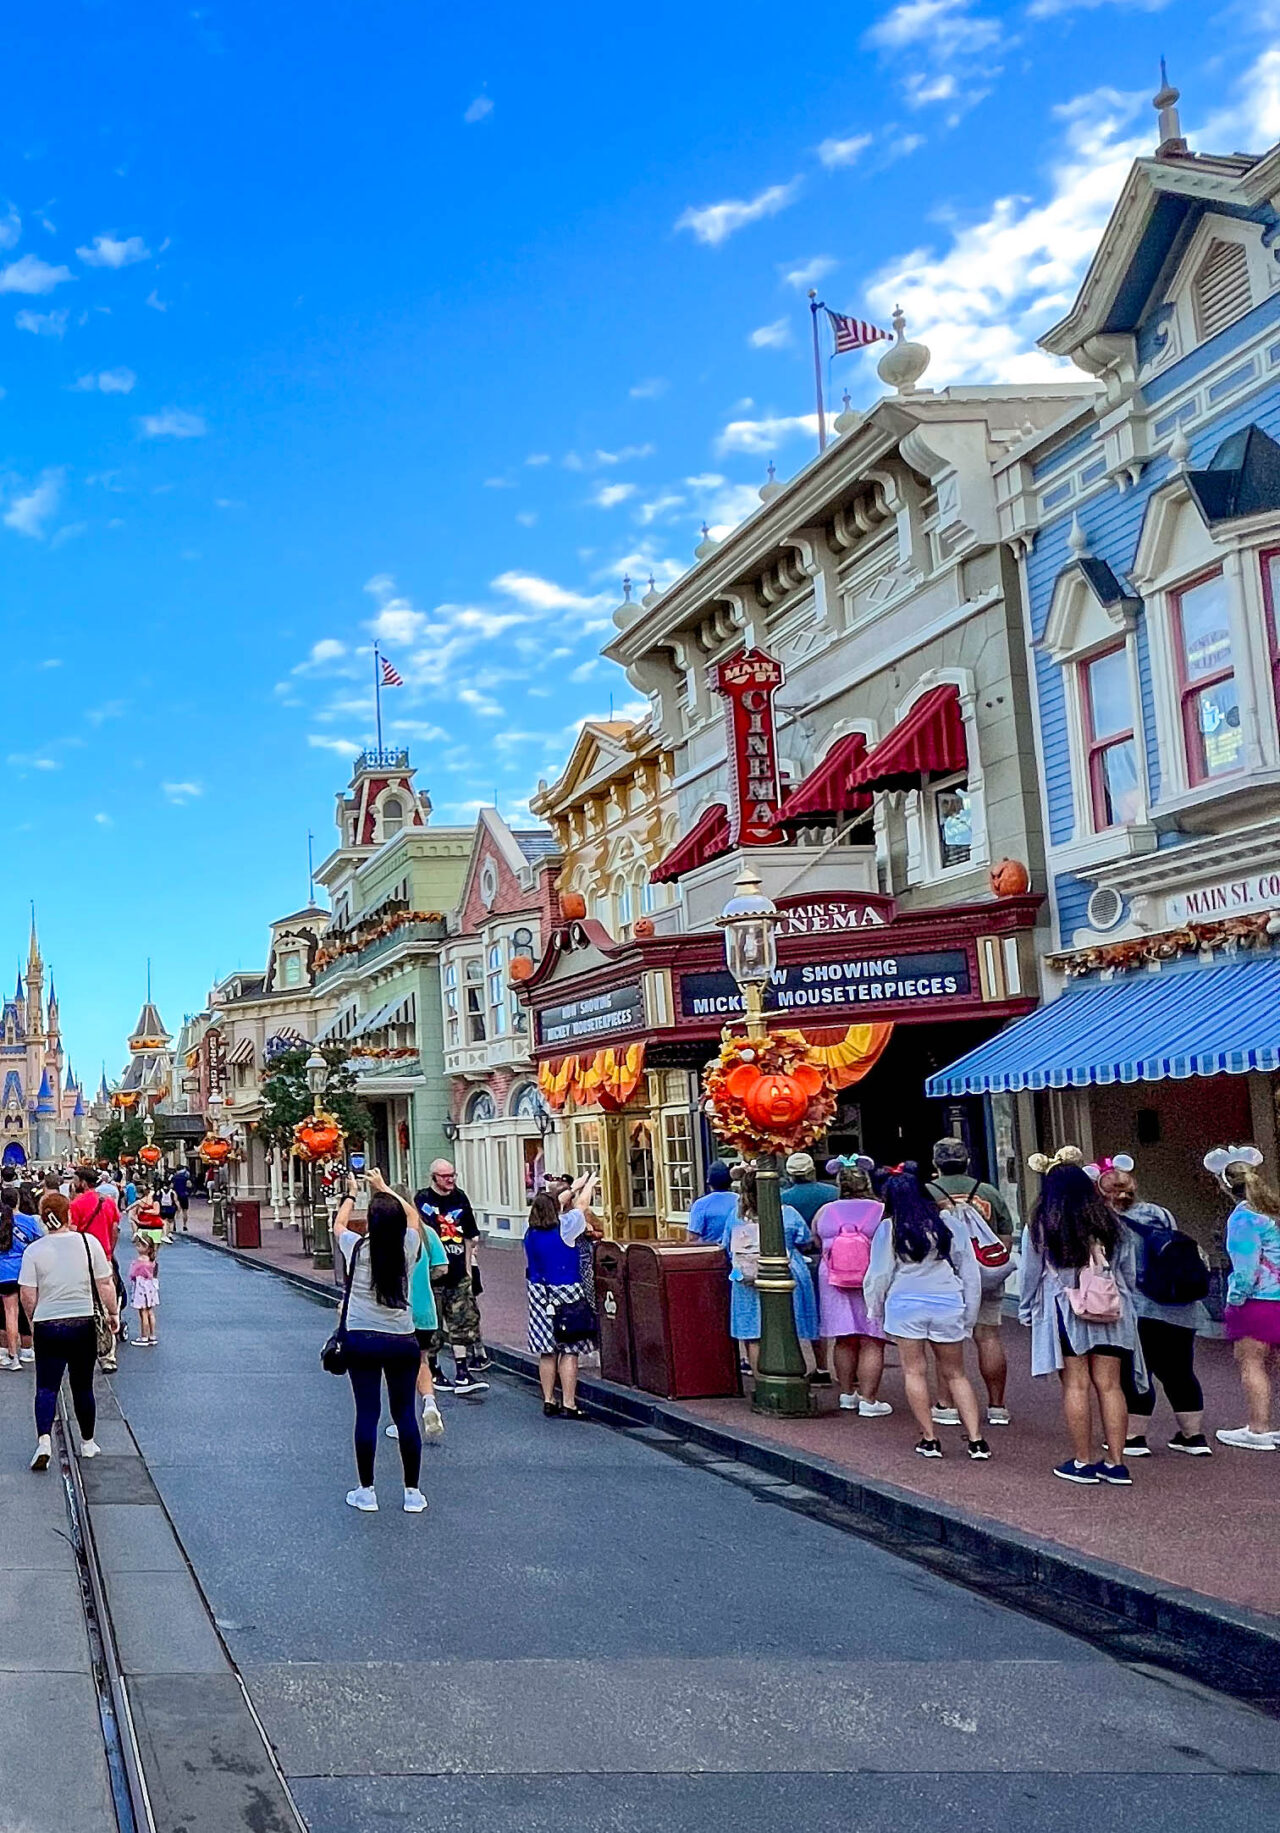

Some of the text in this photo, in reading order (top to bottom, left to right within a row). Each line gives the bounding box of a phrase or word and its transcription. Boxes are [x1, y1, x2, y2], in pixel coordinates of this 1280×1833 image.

[724, 663, 774, 681] MAIN
[741, 689, 776, 823] CINEMA
[828, 903, 849, 914] ST
[1186, 887, 1227, 916] MAIN
[1231, 882, 1254, 905] ST.
[774, 906, 885, 934] INEMA
[802, 960, 898, 983] SHOWING
[778, 977, 958, 1007] MOUSETERPIECES
